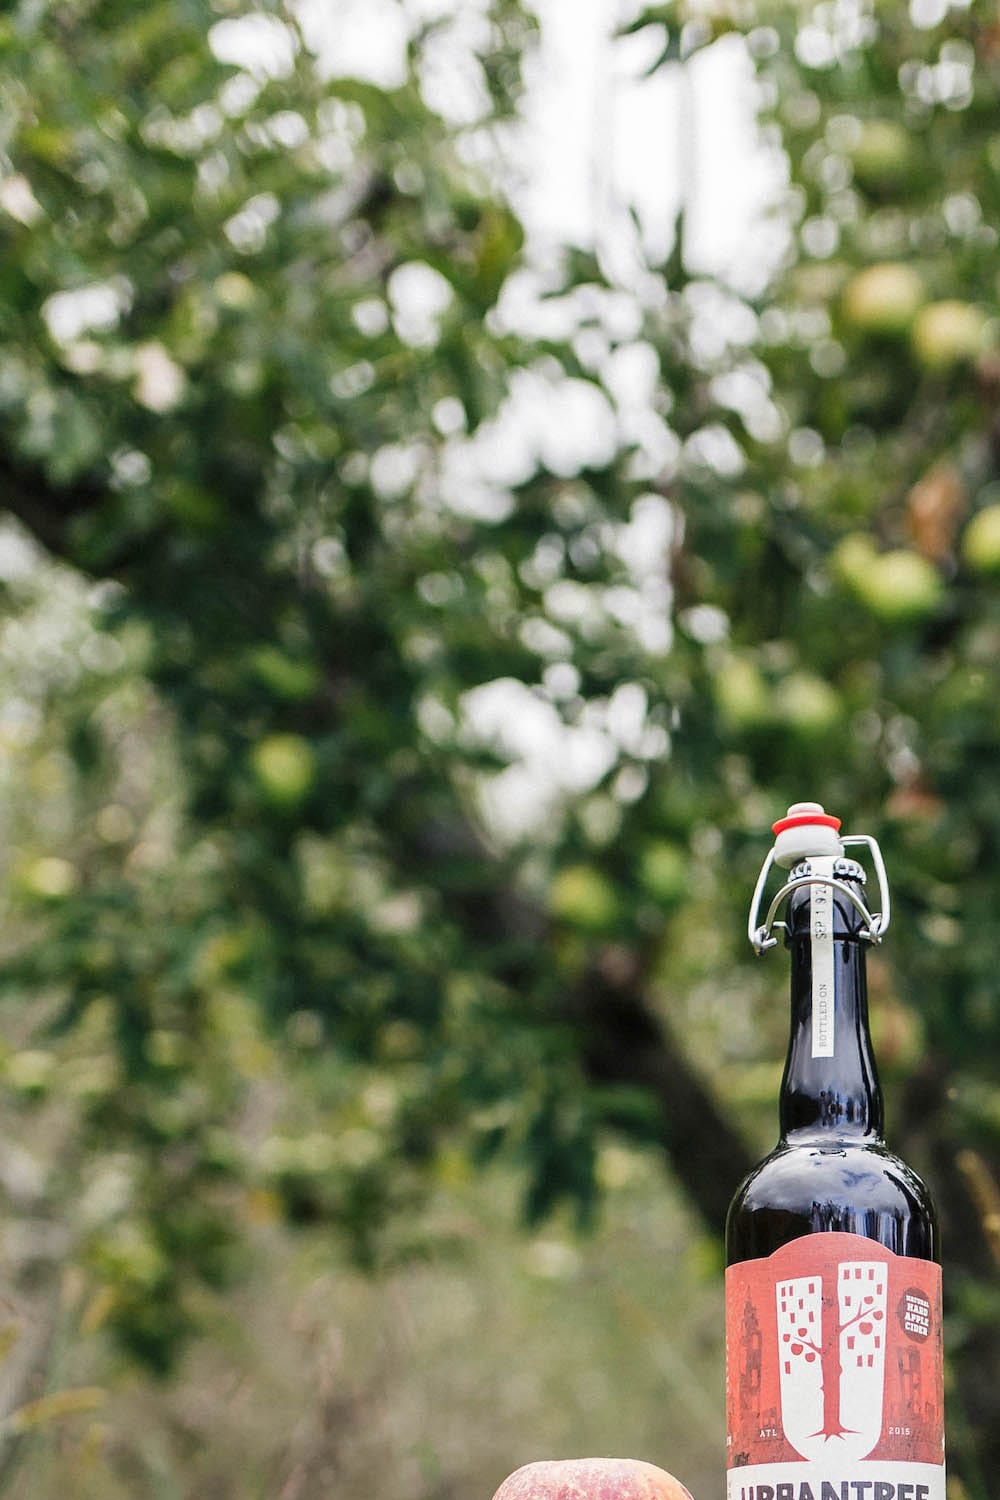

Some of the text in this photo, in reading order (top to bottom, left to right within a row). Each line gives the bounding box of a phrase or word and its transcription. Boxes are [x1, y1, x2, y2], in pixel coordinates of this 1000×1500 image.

[815, 921, 828, 939] SEP
[818, 984, 828, 998] ON
[818, 1001, 828, 1049] BOTTLED
[907, 1302, 929, 1317] HARD
[904, 1311, 929, 1327] APPLE
[904, 1321, 929, 1337] CIDER
[759, 1428, 778, 1438] ATL
[888, 1426, 911, 1436] 2015
